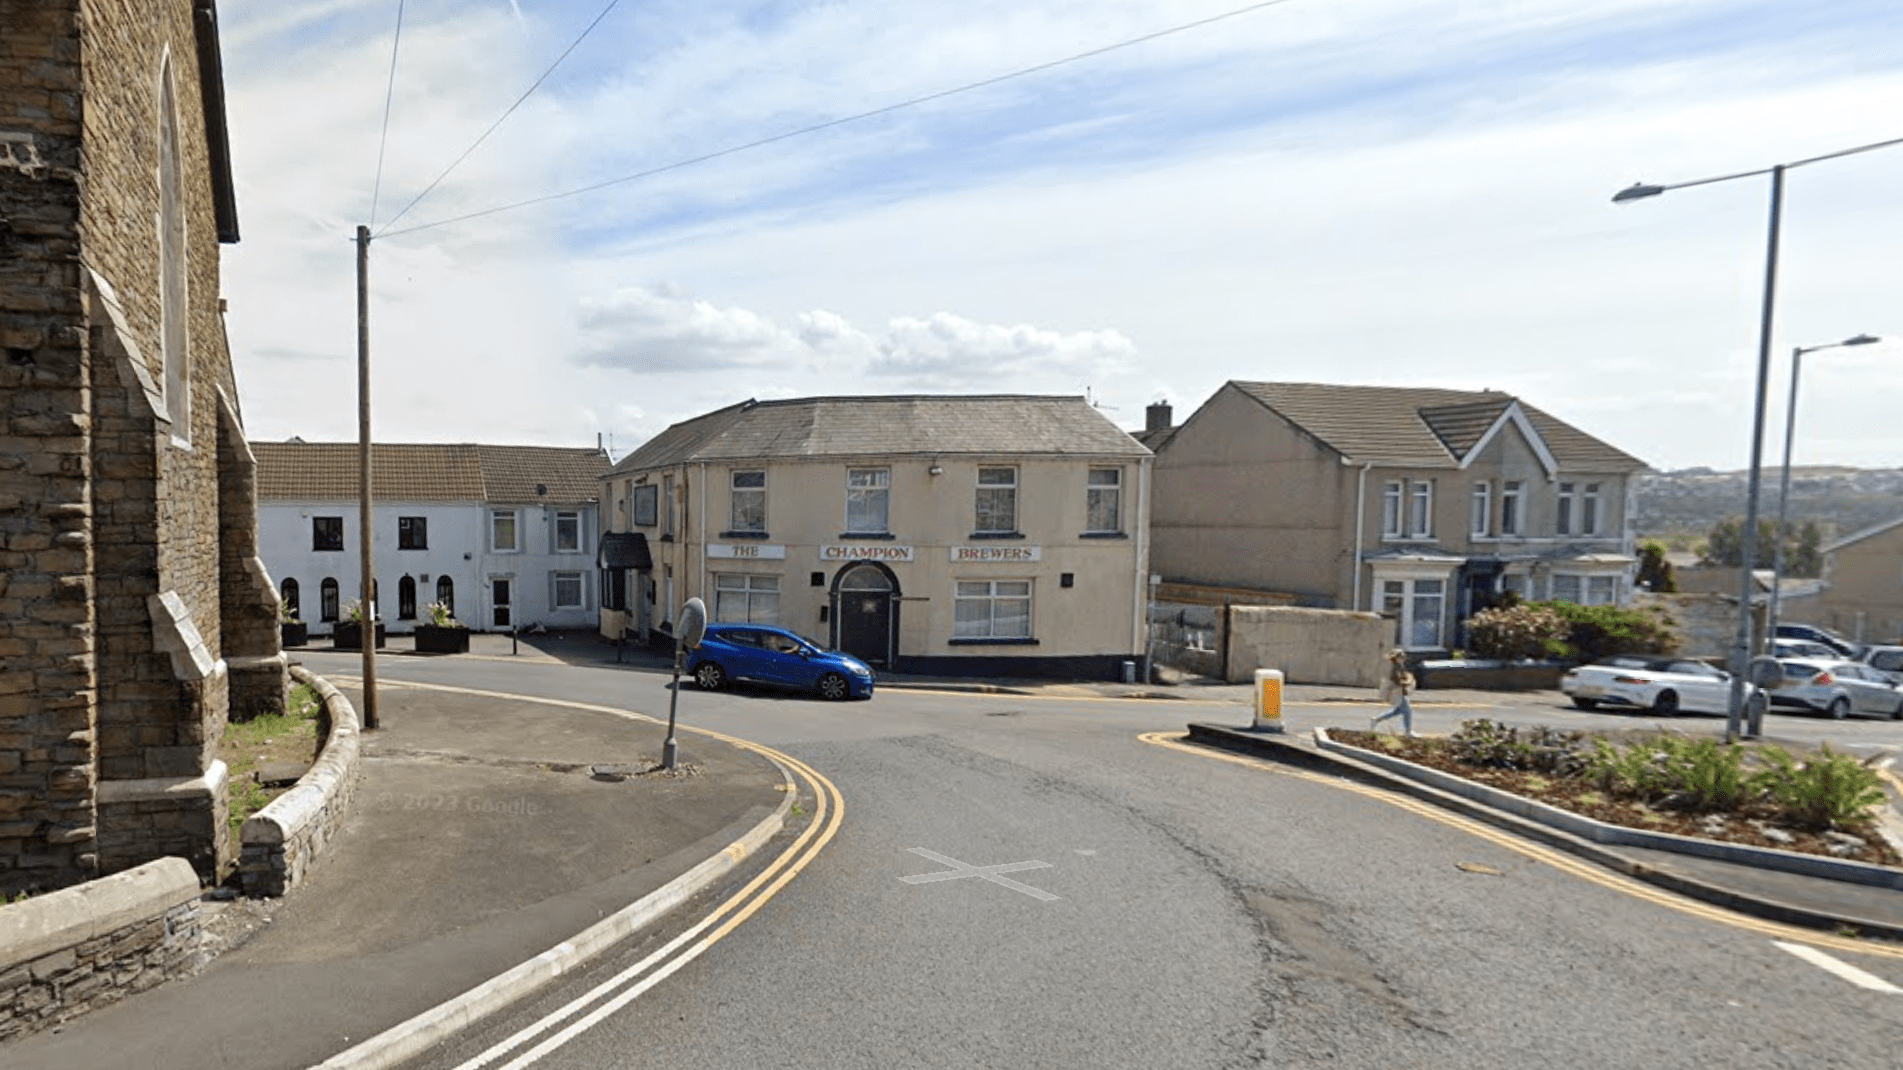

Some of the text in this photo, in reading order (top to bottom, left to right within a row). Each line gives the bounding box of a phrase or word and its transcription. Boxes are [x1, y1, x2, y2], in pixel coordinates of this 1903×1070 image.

[732, 545, 1032, 559] THE CHAMPION BREWERS
